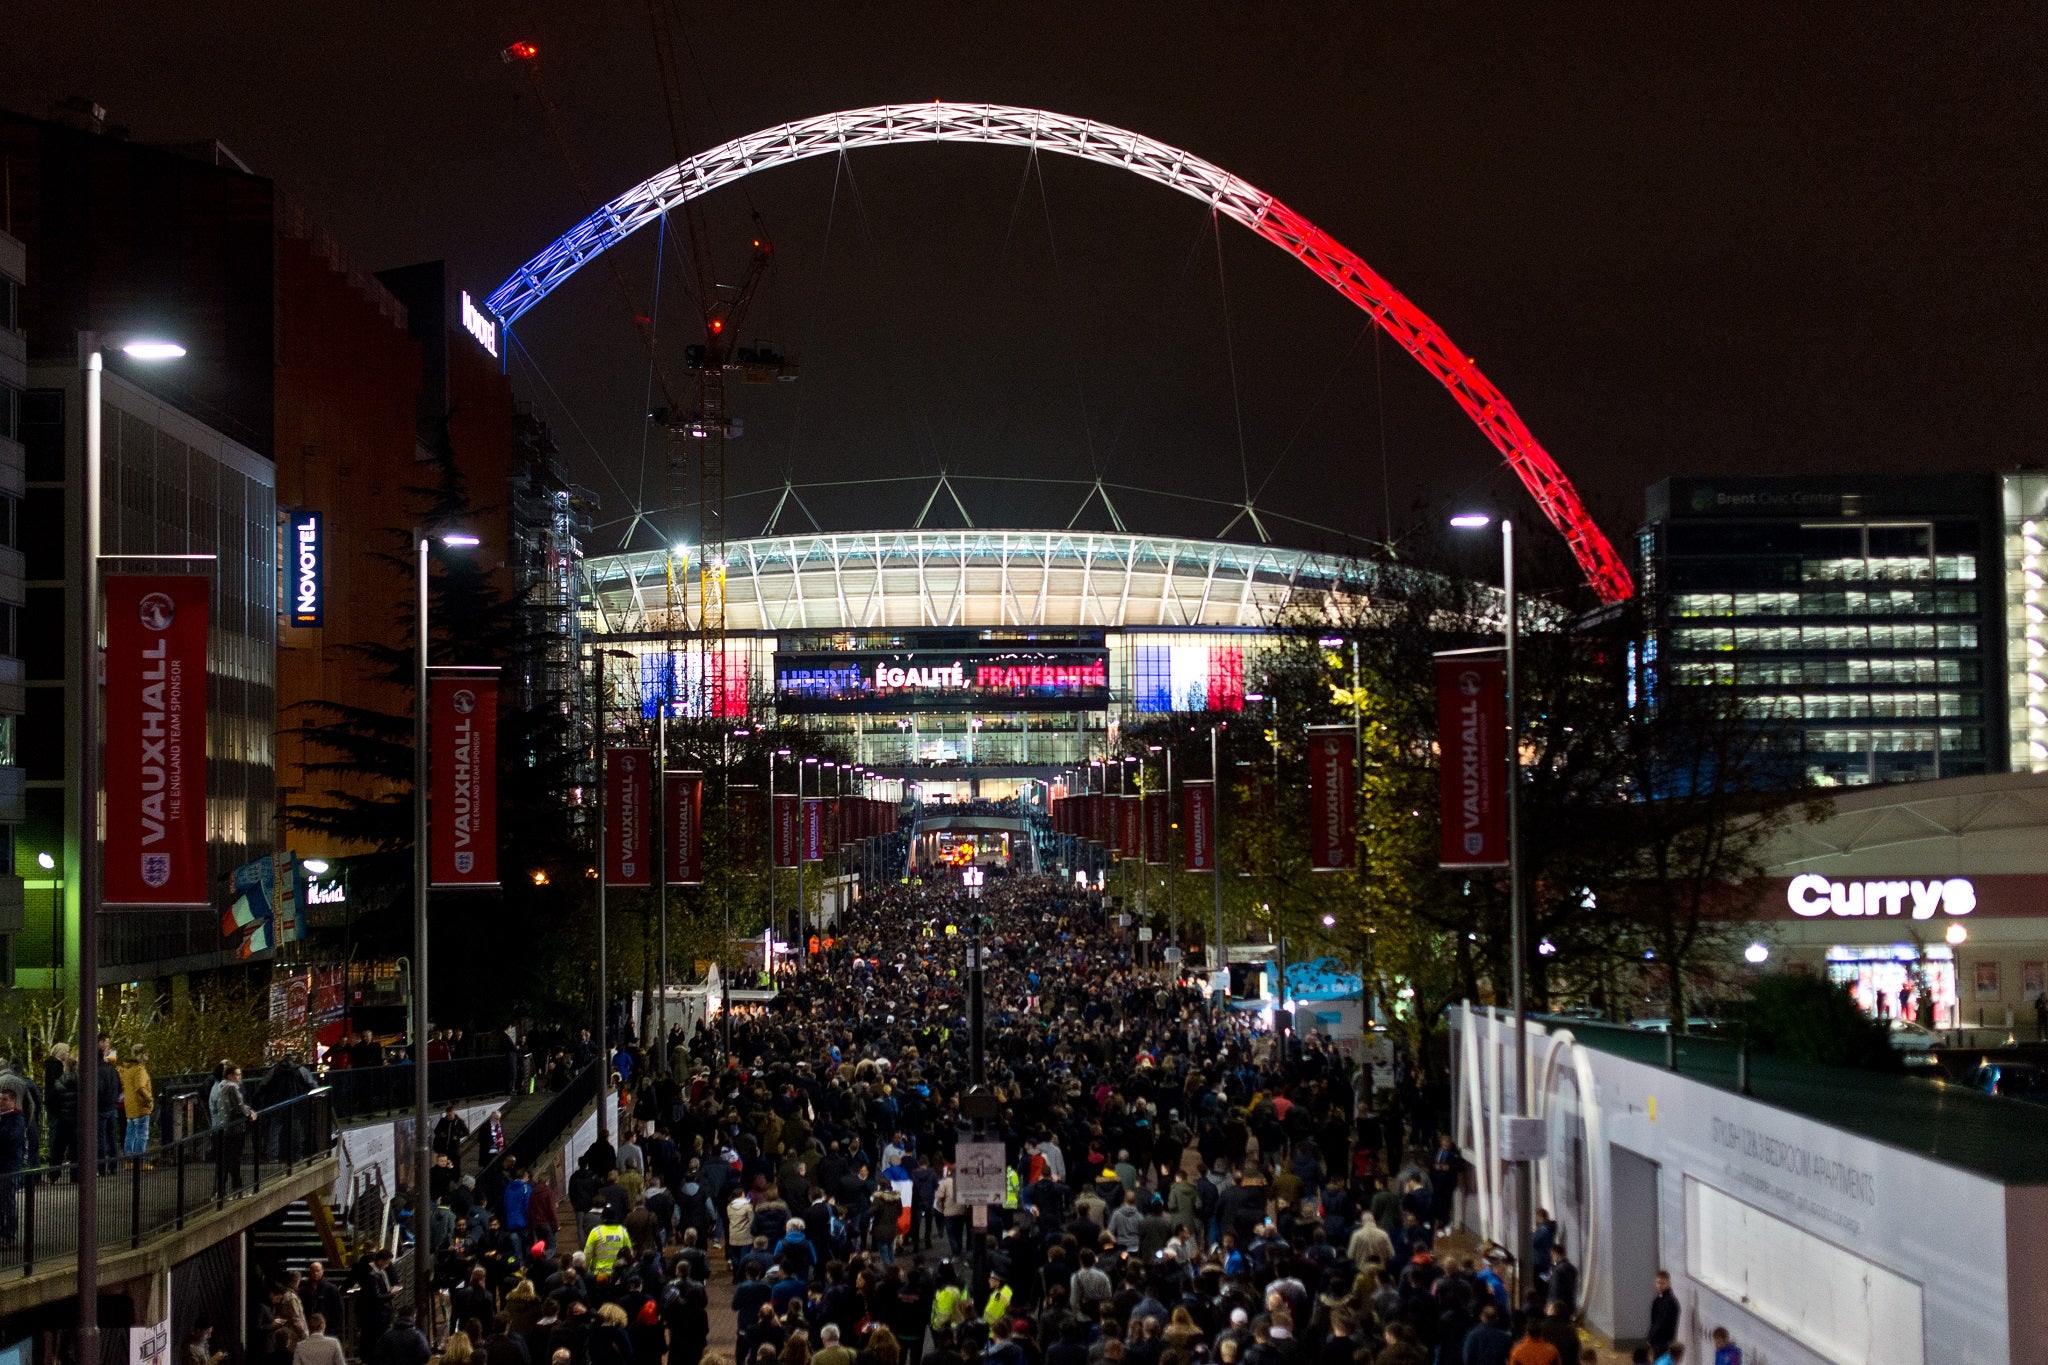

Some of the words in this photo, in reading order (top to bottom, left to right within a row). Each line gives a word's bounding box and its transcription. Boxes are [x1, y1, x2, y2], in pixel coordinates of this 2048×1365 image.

[1716, 491, 1756, 505] Brent
[1759, 491, 1789, 504] Civic
[297, 517, 316, 612] NOVOTEL
[171, 659, 182, 712] SPONSOR
[875, 660, 971, 689] ÉGALITÉ,
[976, 658, 1106, 687] FRATERNITÉ
[141, 638, 167, 847] VAUXHALL
[171, 714, 182, 745] TEAM
[170, 745, 181, 797] ENGLAND
[454, 717, 471, 849] VAUXHALL
[1460, 699, 1481, 830] VAUXHALL
[170, 799, 180, 822] THE
[622, 774, 633, 861] VAUXHALL
[679, 796, 688, 865] VAUXHALL
[1193, 801, 1203, 856] VAUXHALL
[1325, 757, 1339, 848] VAUXHALL
[1787, 873, 1977, 920] Currys
[1765, 1135, 1811, 1179] BEDROOM
[1813, 1154, 1876, 1206] APARTMENTS
